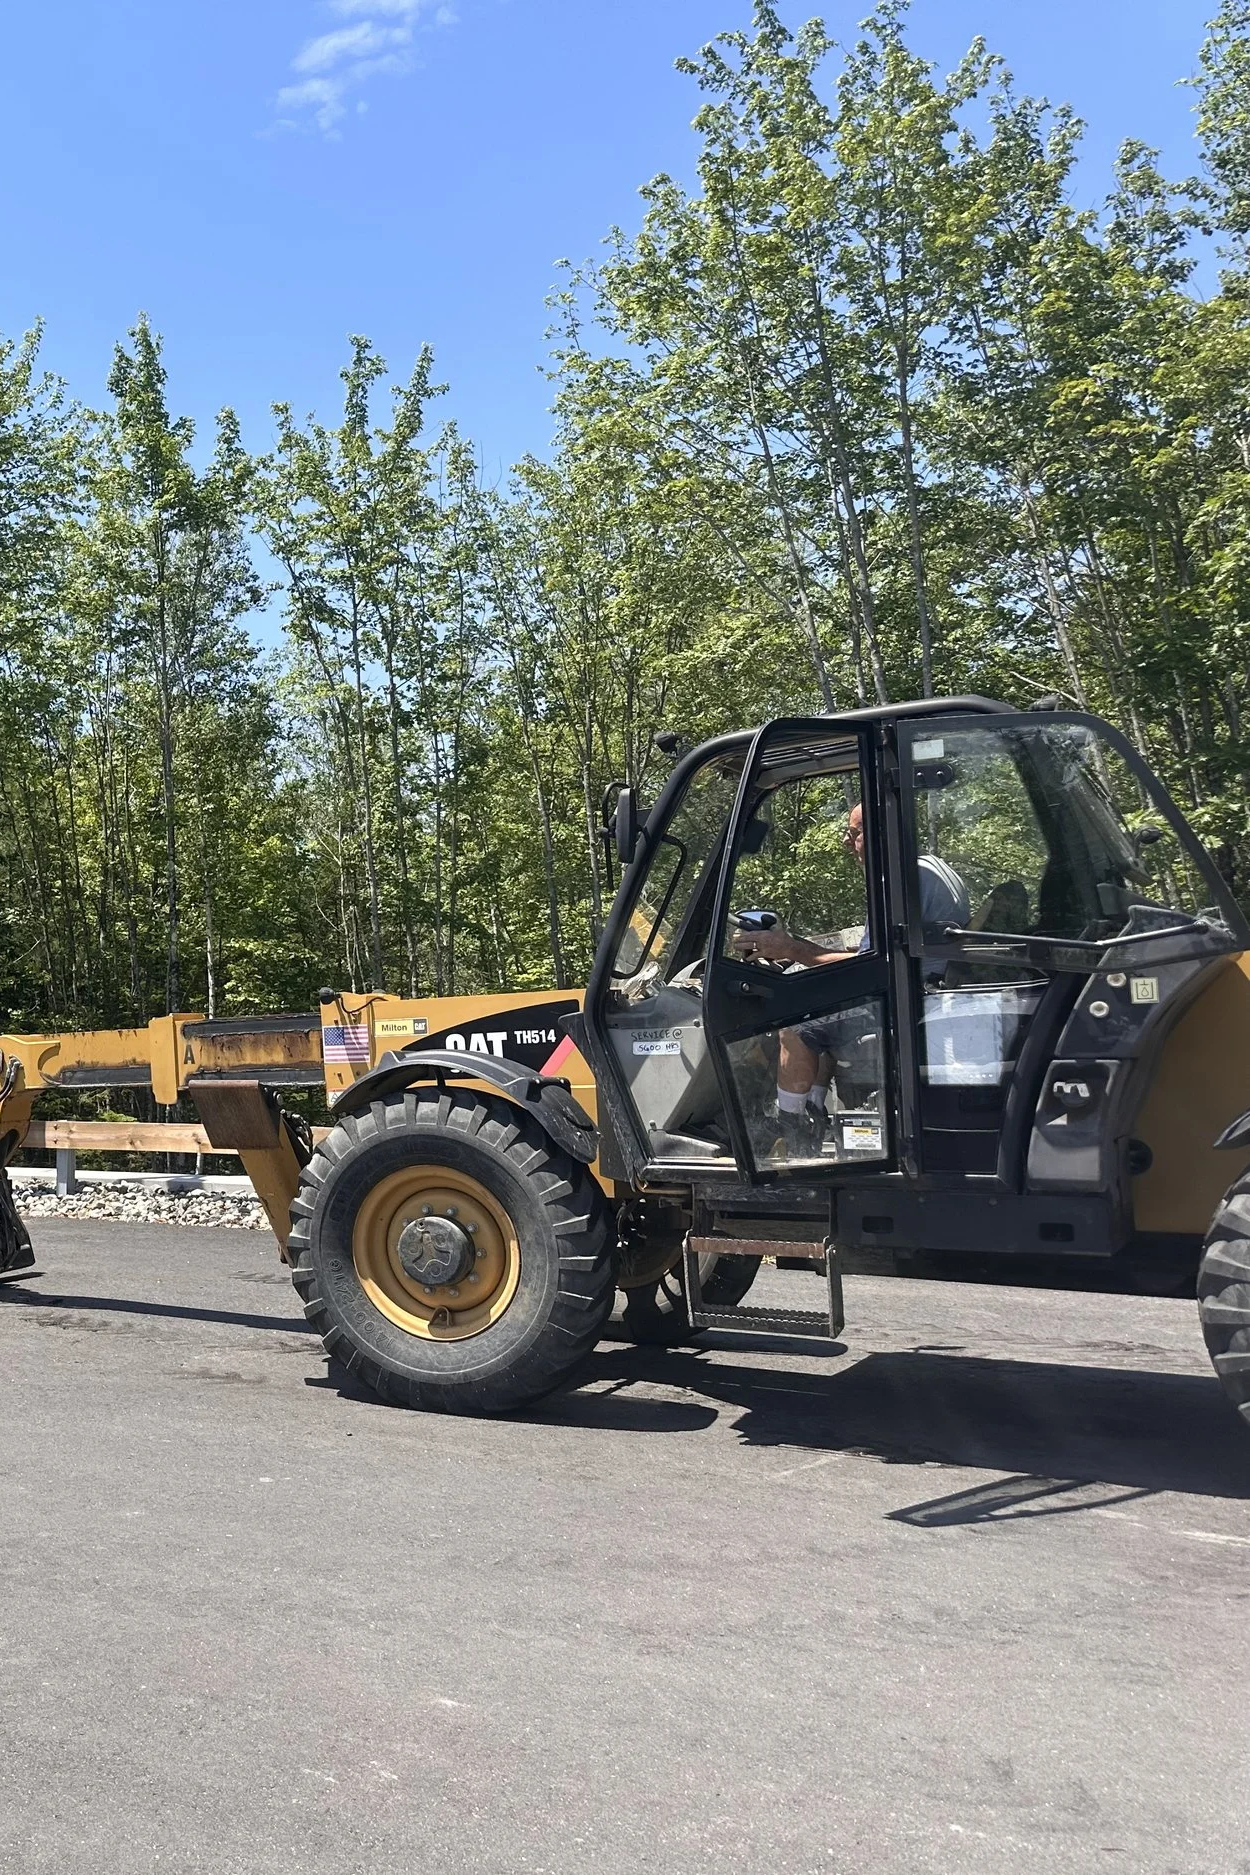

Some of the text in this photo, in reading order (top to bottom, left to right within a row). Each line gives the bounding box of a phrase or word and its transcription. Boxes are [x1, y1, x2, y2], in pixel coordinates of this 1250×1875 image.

[381, 1022, 426, 1032] Milton CAT
[514, 1029, 556, 1044] TH514
[631, 1028, 684, 1041] SERVICE @
[183, 1044, 196, 1065] A
